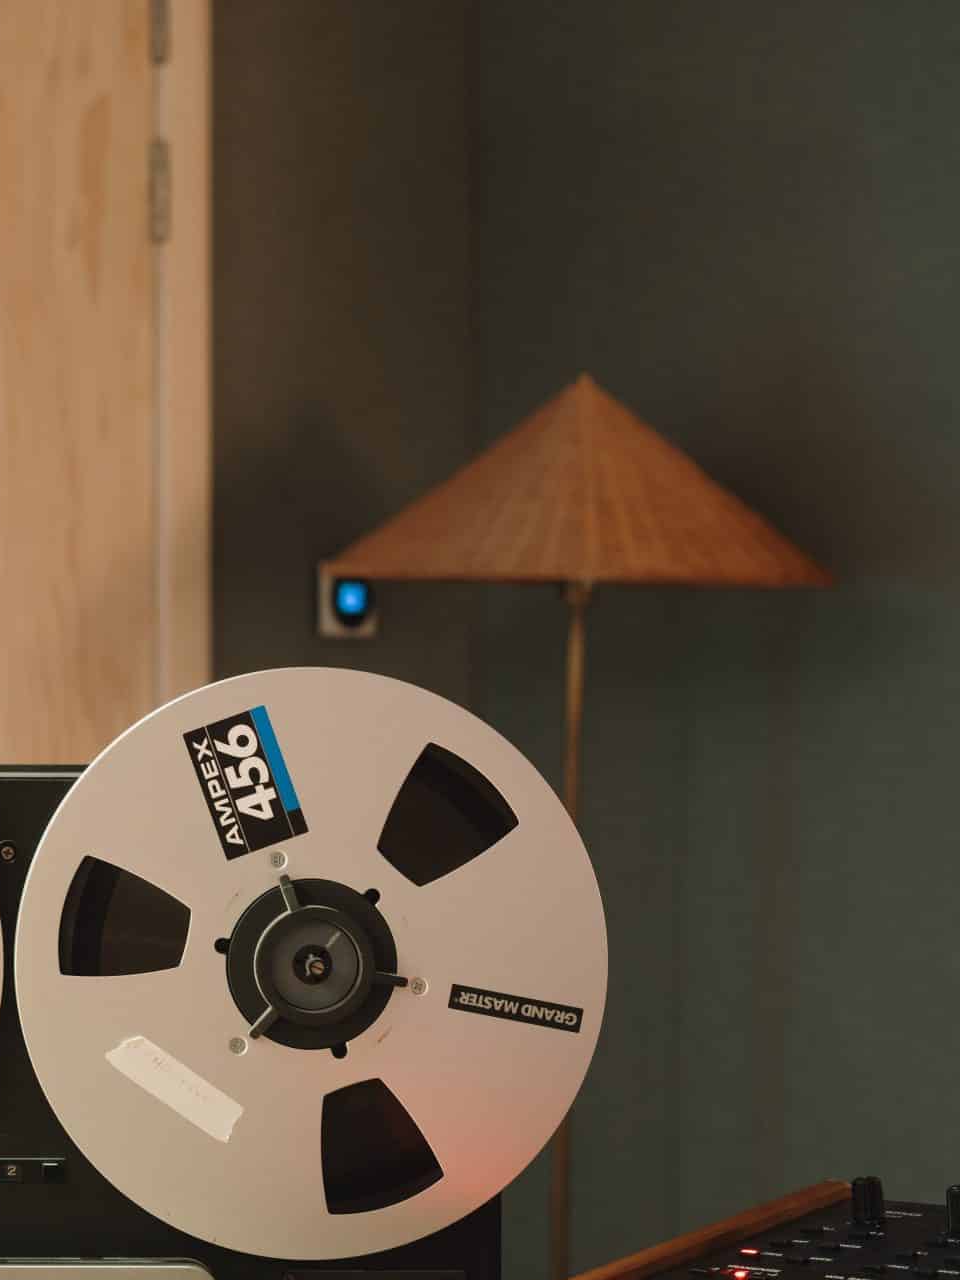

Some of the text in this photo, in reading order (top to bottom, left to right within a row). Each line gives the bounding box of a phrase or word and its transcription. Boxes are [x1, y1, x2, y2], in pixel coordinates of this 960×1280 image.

[192, 736, 245, 846] AMPEX
[213, 723, 277, 821] 456
[460, 991, 578, 1026] GRAND MASTER
